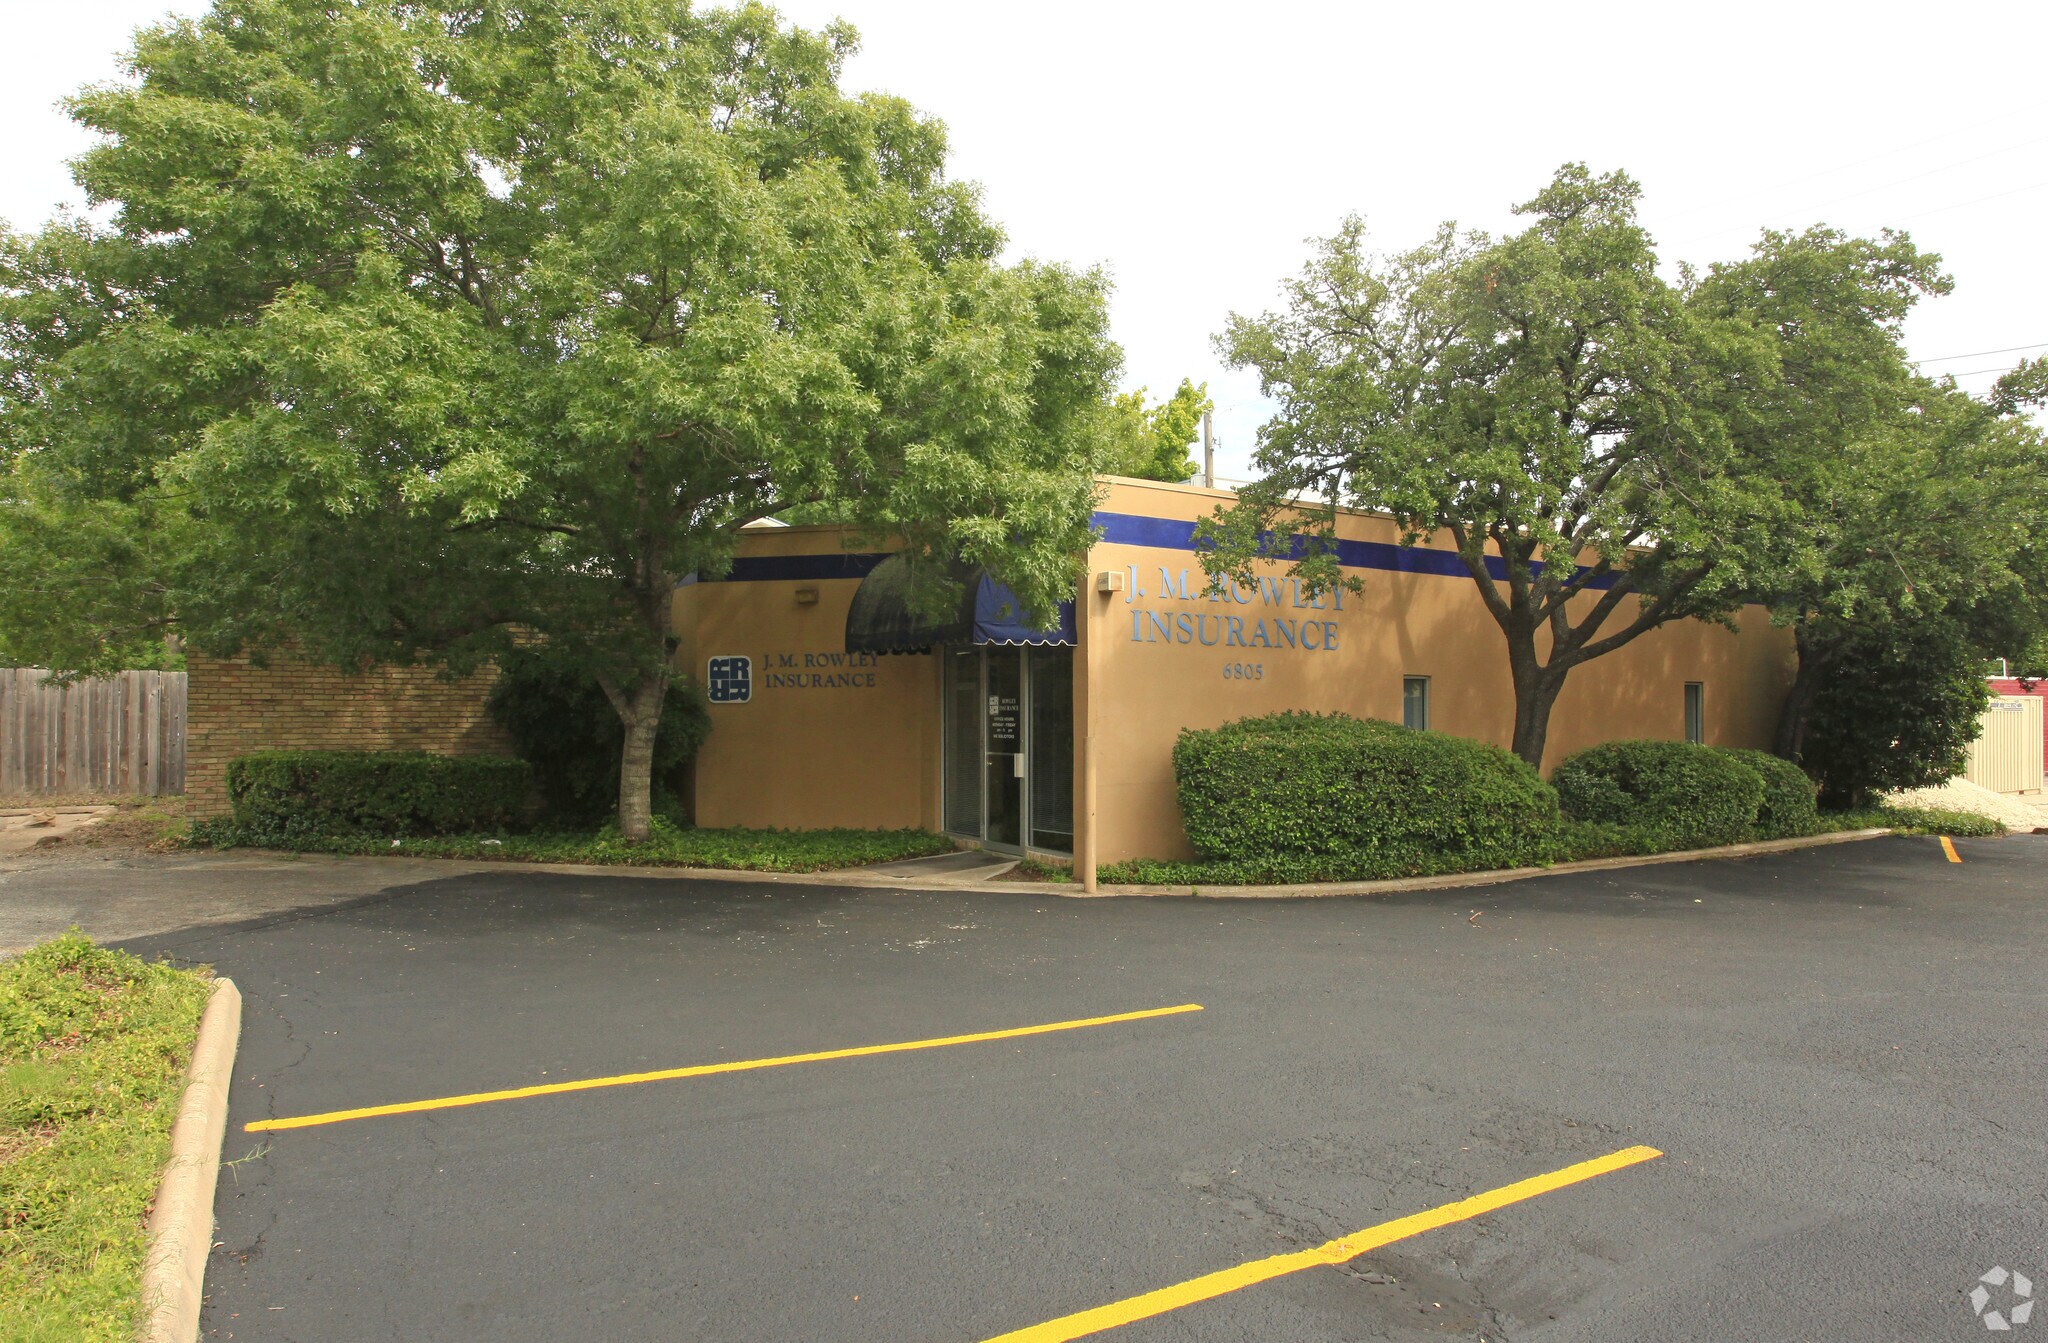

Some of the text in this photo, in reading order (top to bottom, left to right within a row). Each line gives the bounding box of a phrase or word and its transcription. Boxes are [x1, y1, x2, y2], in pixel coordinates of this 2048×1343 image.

[1125, 564, 1145, 603] J.
[1158, 566, 1198, 601] M.
[1130, 609, 1340, 651] INSURANCE
[763, 653, 879, 671] J. M. ROWLEY
[1222, 662, 1264, 680] 6805
[765, 673, 876, 688] INSURANCE
